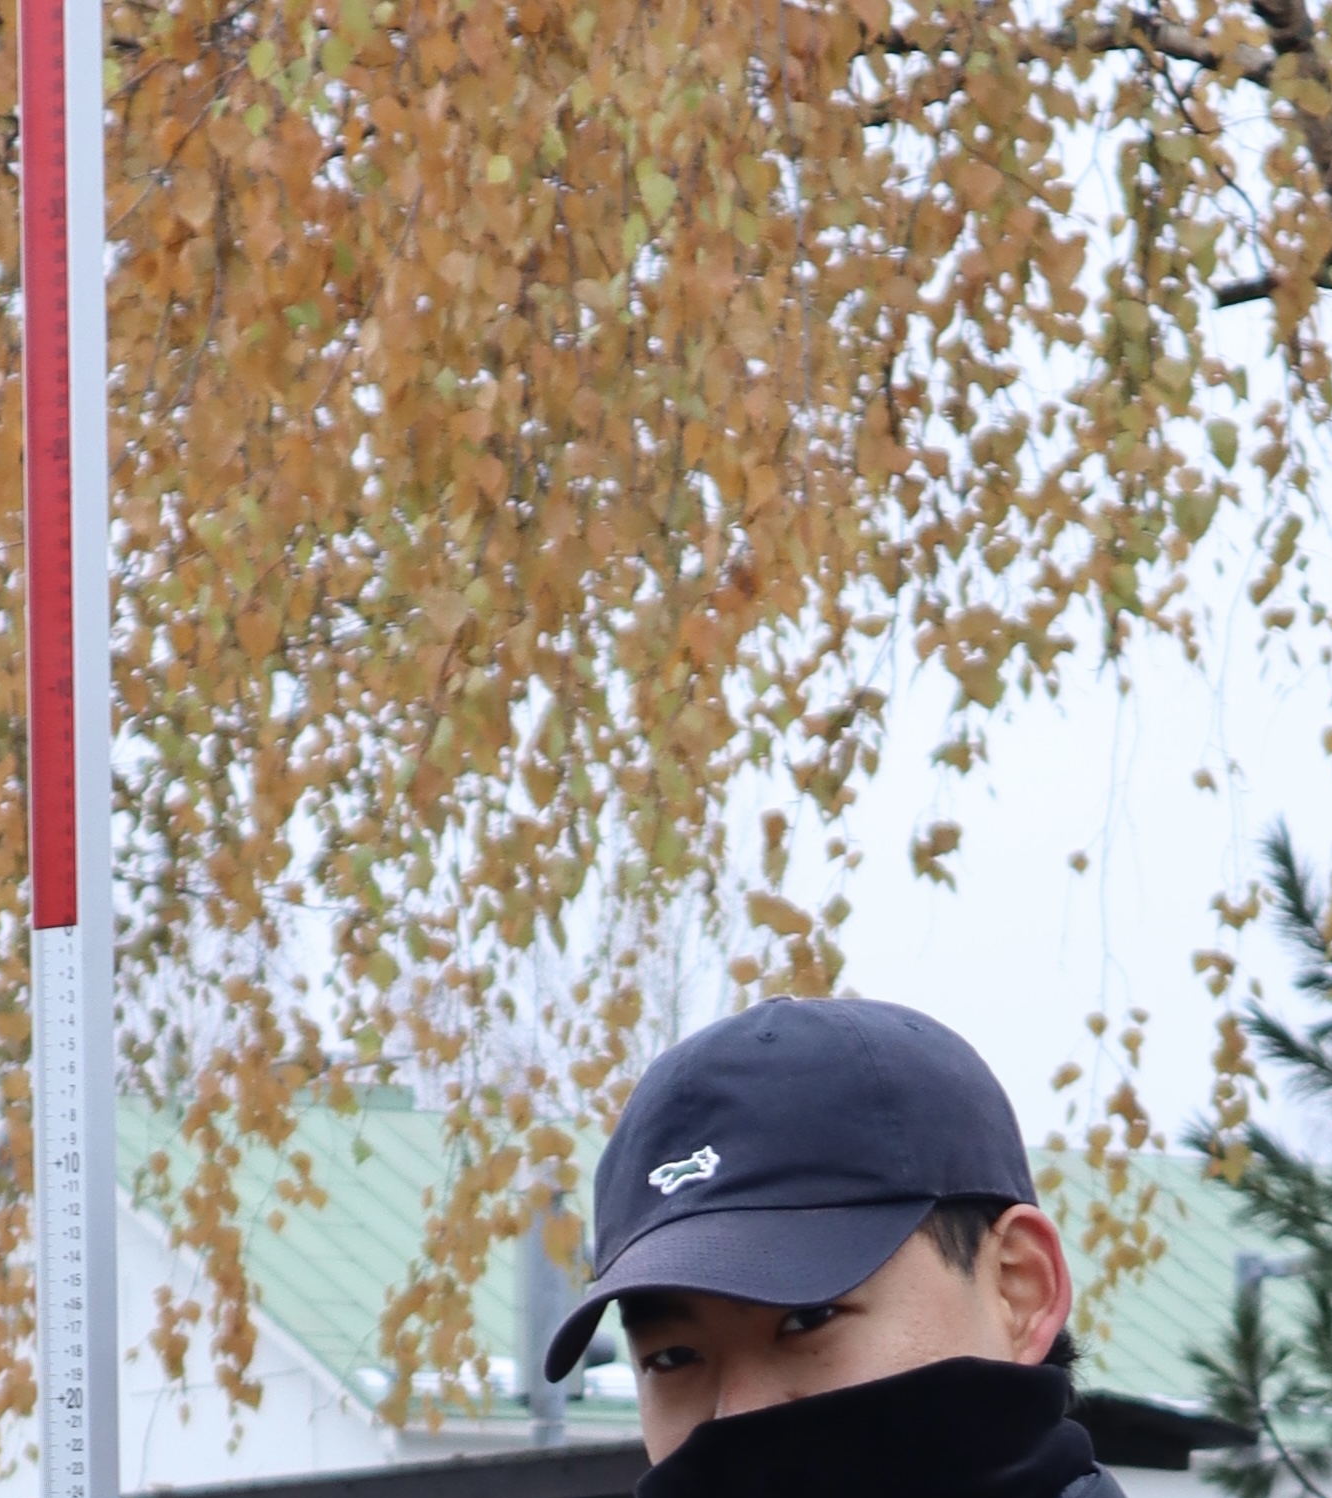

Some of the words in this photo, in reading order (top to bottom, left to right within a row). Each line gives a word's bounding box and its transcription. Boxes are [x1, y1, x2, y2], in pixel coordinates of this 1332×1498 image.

[54, 1152, 80, 1174] +10
[62, 1180, 80, 1192] +11
[62, 1204, 80, 1216] +12
[63, 1226, 80, 1238] +13
[63, 1250, 81, 1262] +14
[64, 1272, 81, 1286] +15
[64, 1296, 82, 1310] +16
[64, 1320, 82, 1332] +17
[65, 1344, 82, 1358] +18
[65, 1368, 83, 1382] +19
[58, 1388, 83, 1409] +20
[65, 1416, 83, 1428] +21
[66, 1438, 84, 1452] +22
[66, 1462, 84, 1474] +23
[66, 1486, 84, 1498] +24
